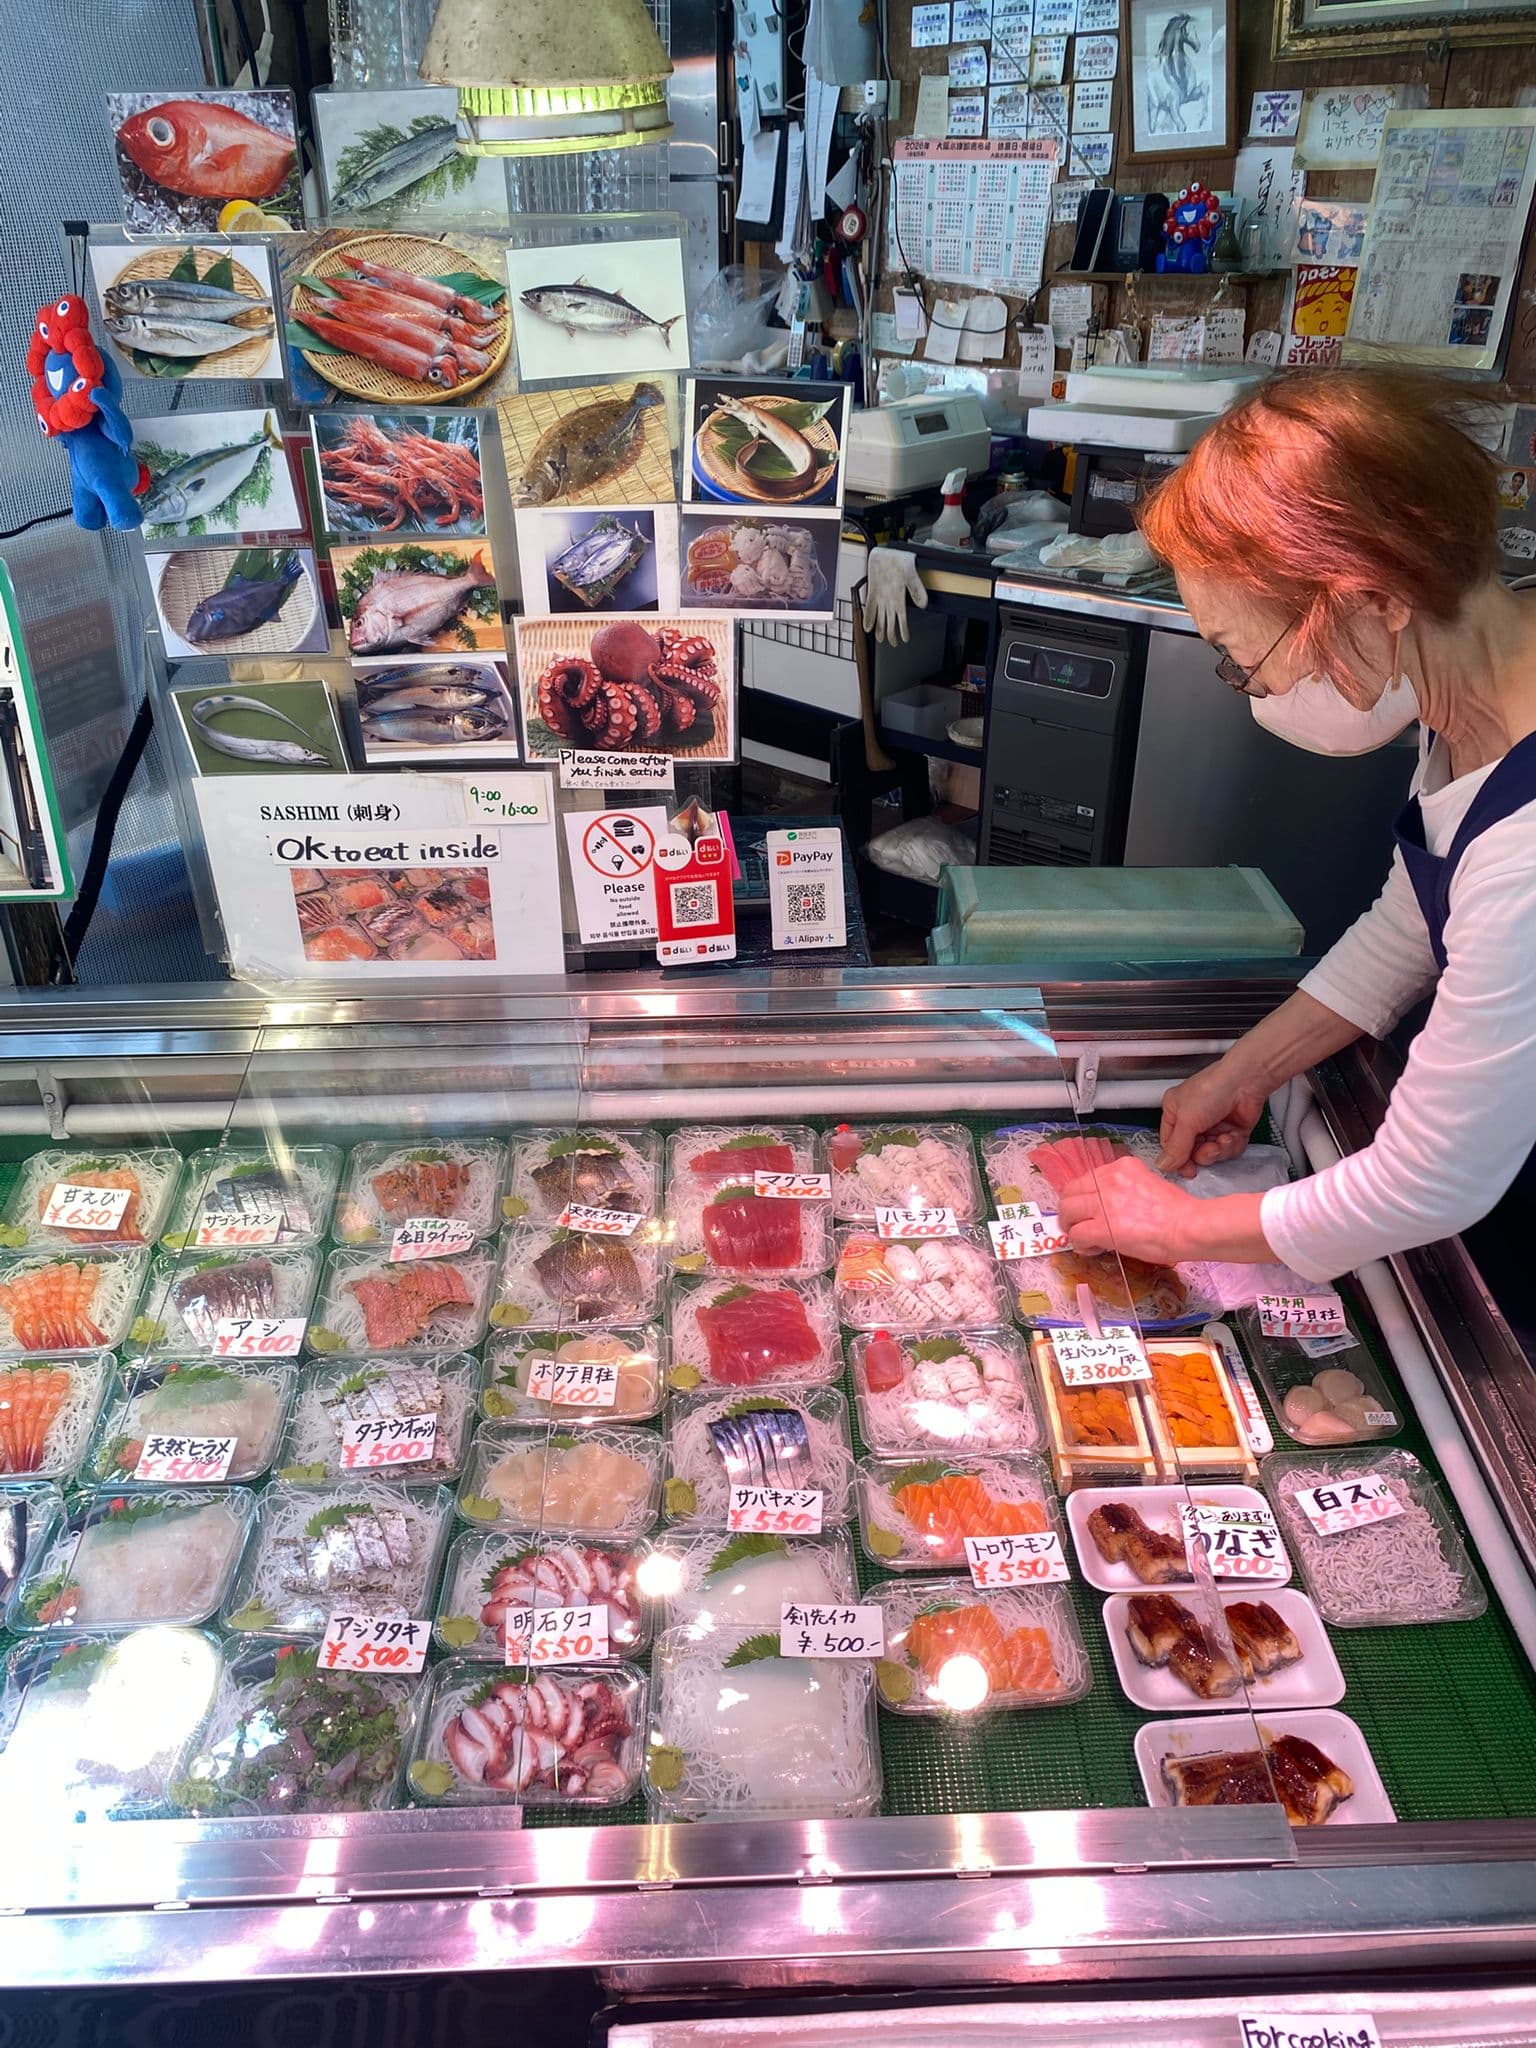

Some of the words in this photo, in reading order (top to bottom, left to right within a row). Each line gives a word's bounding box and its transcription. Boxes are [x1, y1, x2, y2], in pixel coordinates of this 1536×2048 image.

[1287, 349, 1341, 365] STAM
[560, 750, 606, 765] Please
[607, 755, 638, 765] come
[639, 755, 671, 768] after
[570, 767, 592, 777] you
[594, 766, 626, 778] finish
[629, 767, 667, 778] eating
[469, 786, 502, 804] 9:00
[260, 805, 341, 821] SASHIMI
[346, 803, 402, 824] (刺身)
[501, 804, 539, 817] 16:00
[277, 835, 330, 861] OK
[331, 844, 360, 863] to
[363, 842, 410, 862] eat
[419, 834, 500, 860] inside
[793, 851, 834, 863] PayPay
[603, 883, 646, 895] Please
[619, 895, 641, 903] outside
[616, 910, 639, 918] allowed
[760, 1174, 821, 1187] マグロ
[62, 1187, 124, 1207] 甘えび
[1262, 1307, 1341, 1323] ホタテ貝柱
[230, 1319, 286, 1339] アジ
[535, 1363, 615, 1384] ホタテ貝柱
[147, 1437, 231, 1458] 天然ヒラメ
[735, 1490, 816, 1510] サバキズシ
[1312, 1484, 1374, 1512] 白ス
[970, 1534, 1057, 1563] トロサーモン
[333, 1617, 421, 1645] アジタタキ
[511, 1609, 592, 1634] 明石タコ
